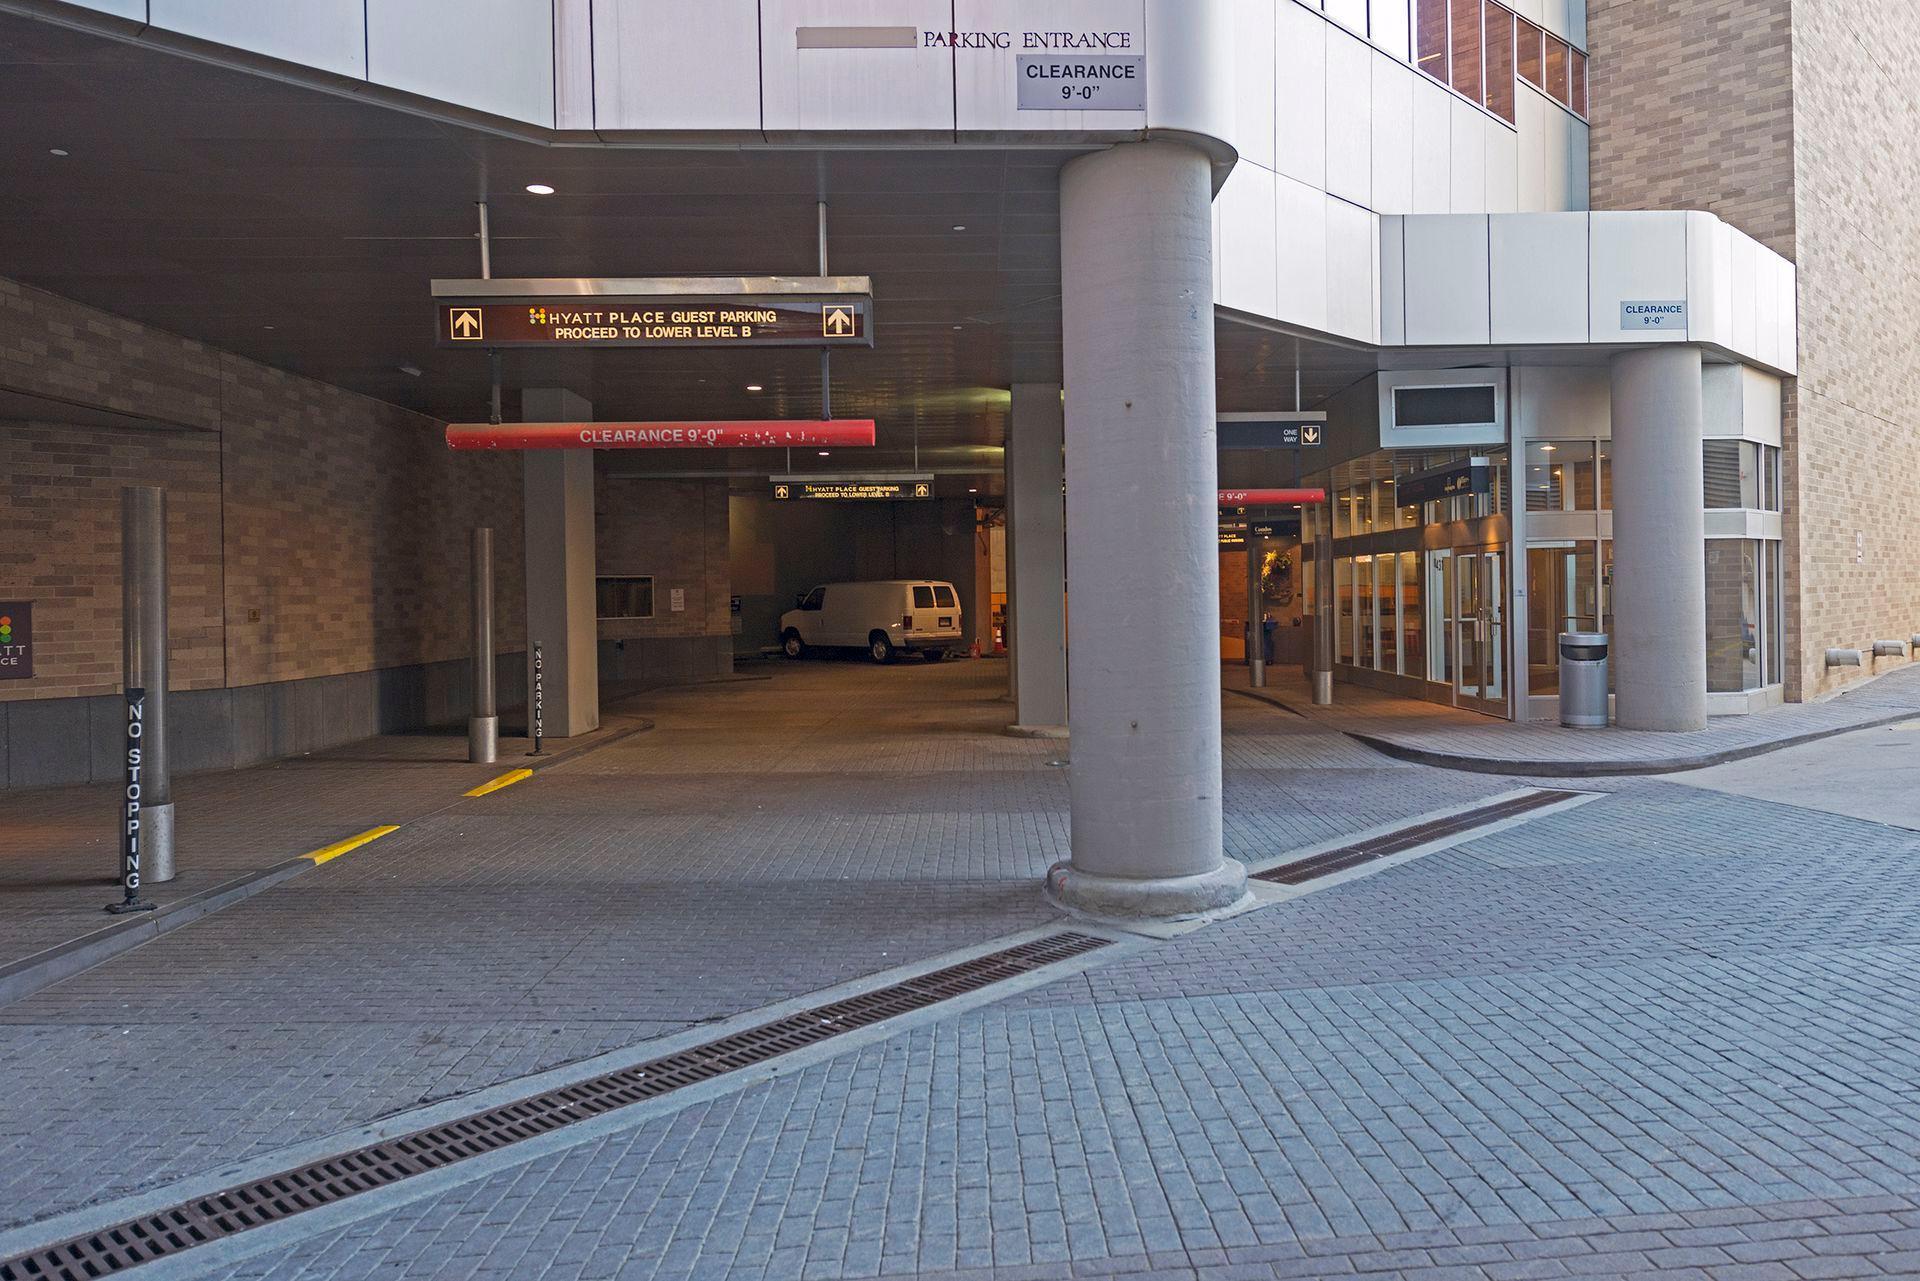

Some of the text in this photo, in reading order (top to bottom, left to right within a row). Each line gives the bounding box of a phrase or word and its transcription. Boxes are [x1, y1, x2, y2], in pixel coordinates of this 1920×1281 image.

[923, 31, 1131, 49] PARKING ENTRANCE
[1026, 64, 1136, 79] CLEARANCE
[1625, 305, 1682, 314] CLEARANCE
[550, 311, 777, 324] HYATT PLACE GUEST PARKING
[555, 326, 751, 339] PROCEED TO LOWER LEVEL B
[580, 428, 684, 443] CLEARANCE
[1283, 428, 1298, 436] ONE
[0, 645, 26, 656] TT
[535, 648, 542, 669] NO
[127, 704, 142, 738] NO
[125, 748, 141, 889] STOPPING
